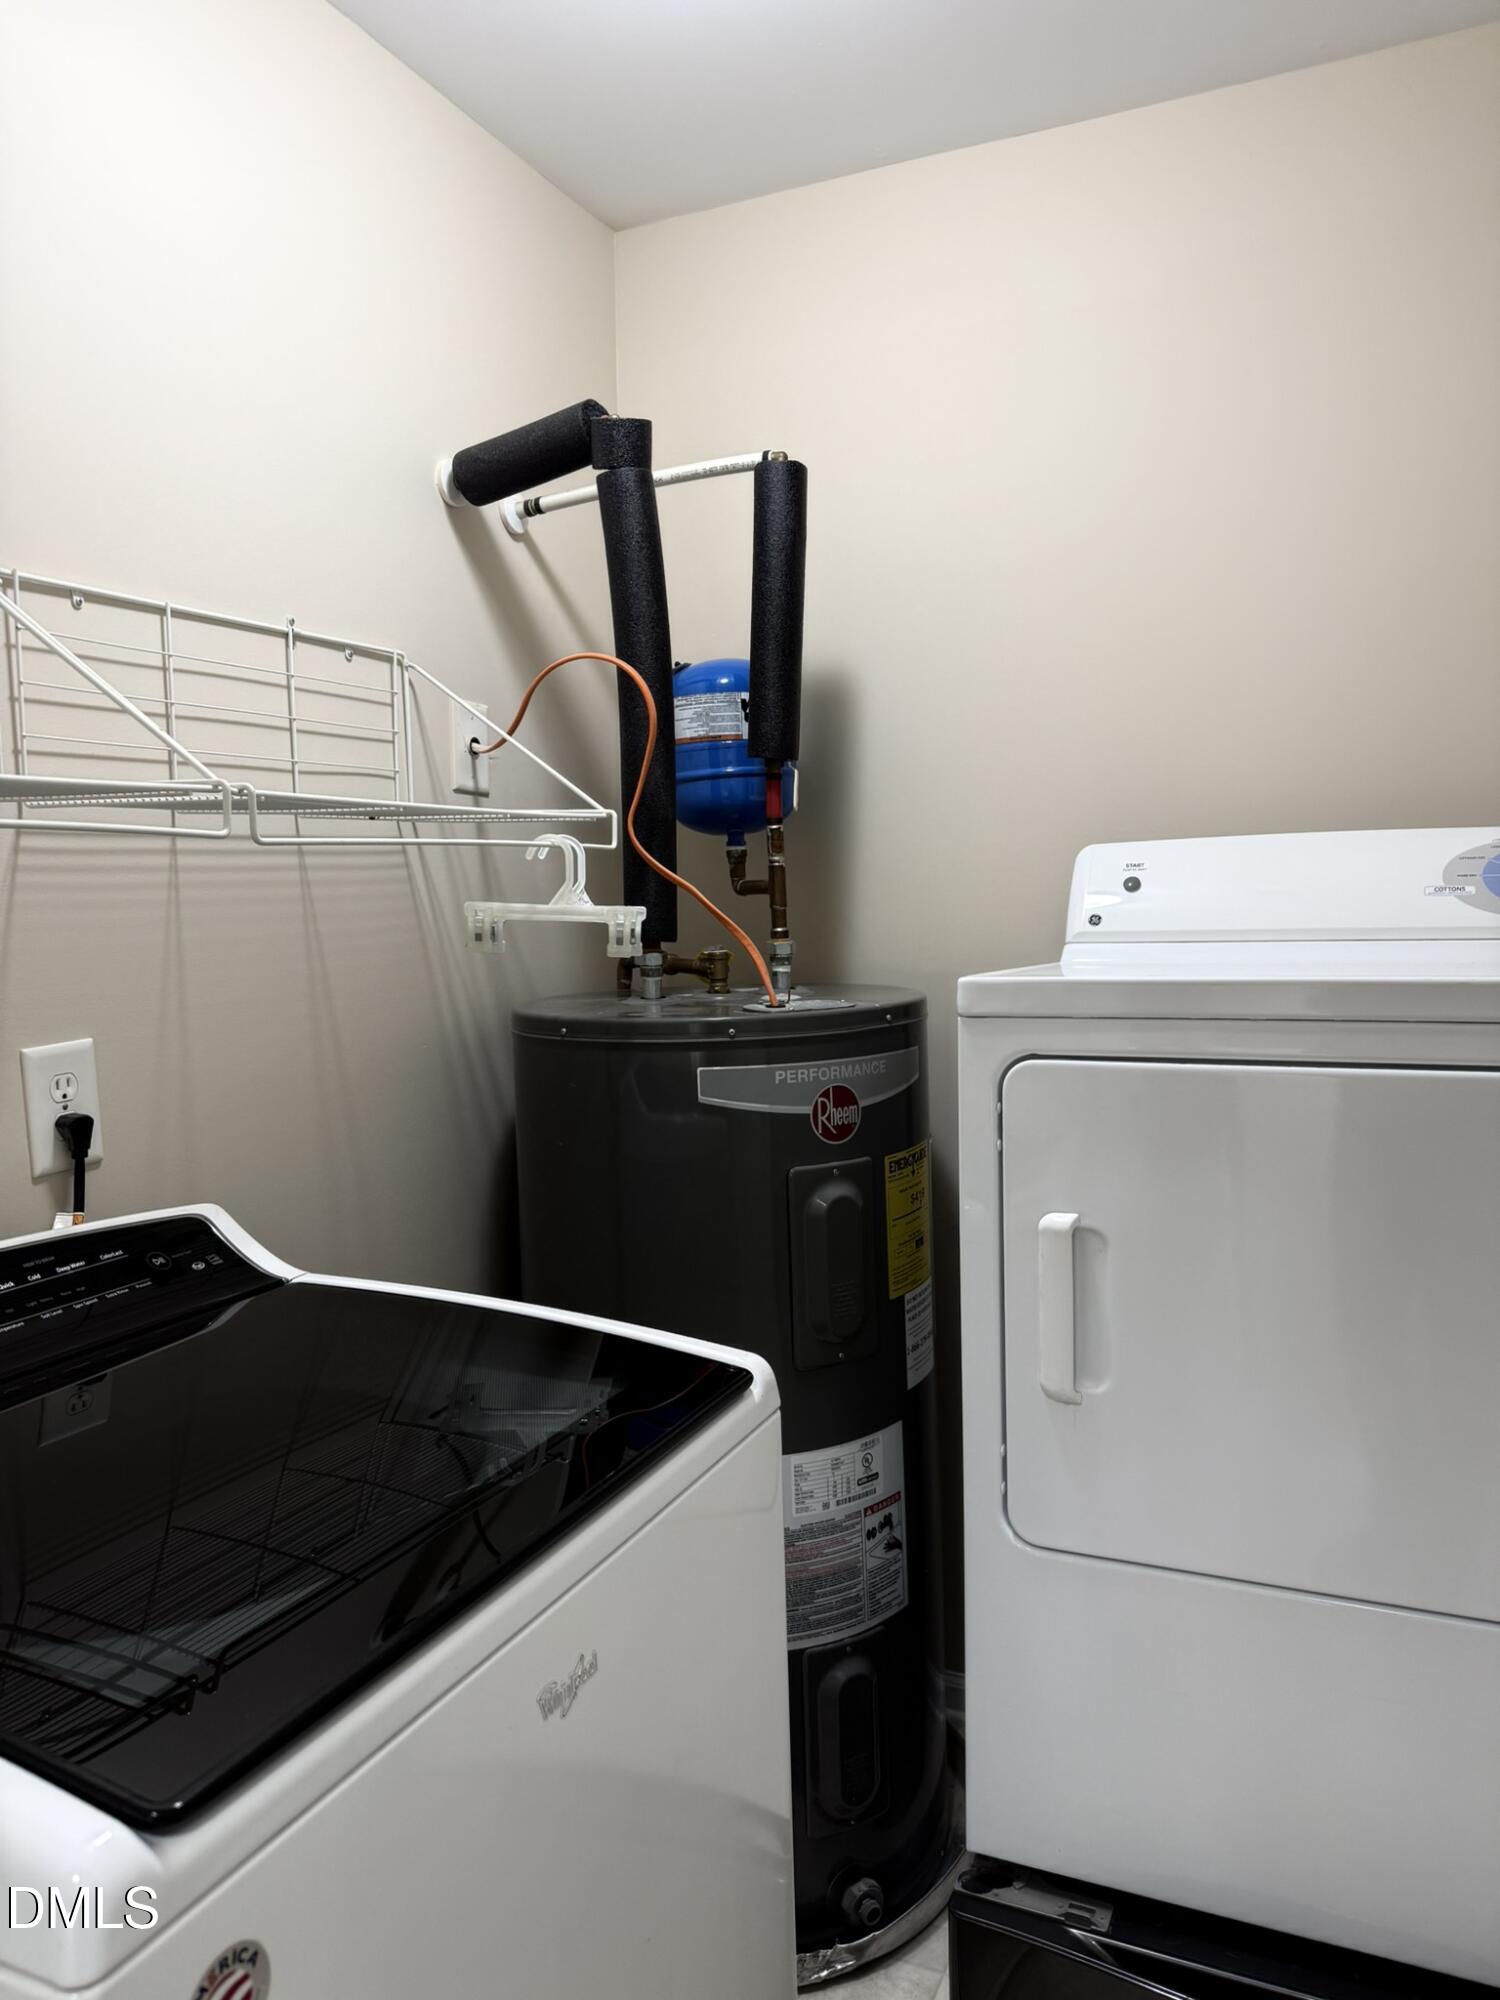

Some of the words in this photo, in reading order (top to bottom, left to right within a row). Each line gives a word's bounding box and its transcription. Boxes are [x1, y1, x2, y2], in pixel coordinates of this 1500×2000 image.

[775, 1060, 887, 1084] PERFORMANCE
[818, 1087, 858, 1134] Rheem
[27, 1273, 42, 1281] Cold
